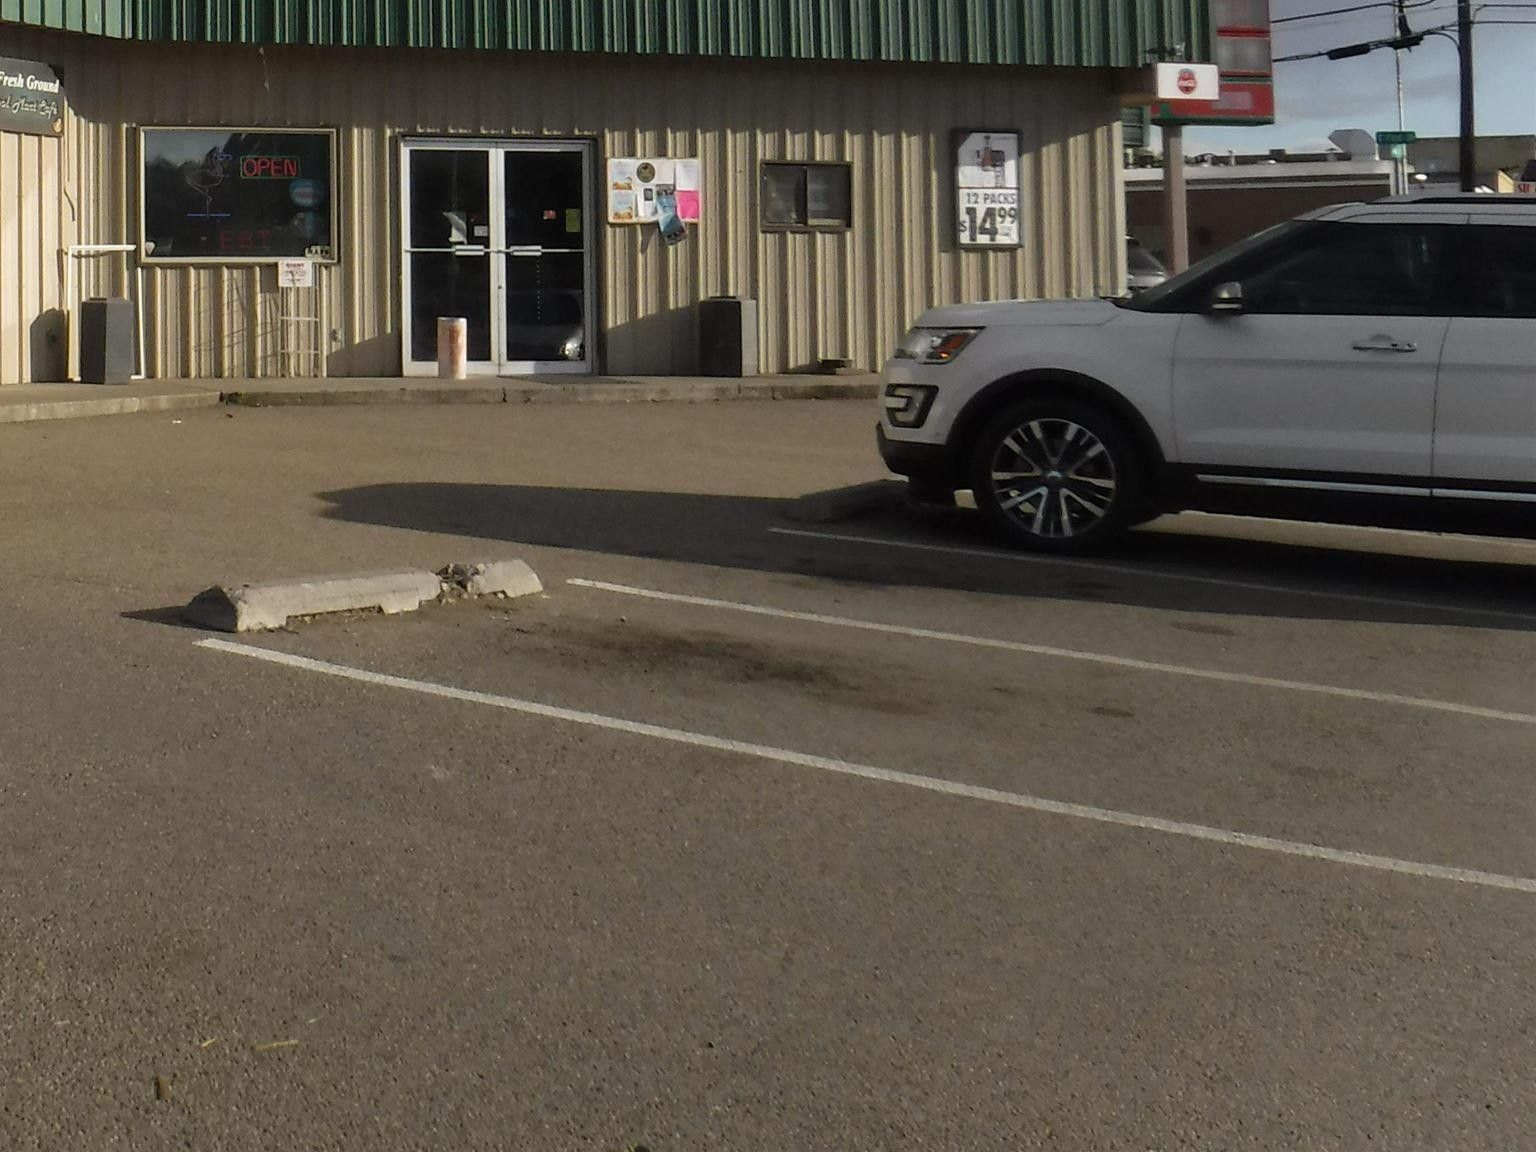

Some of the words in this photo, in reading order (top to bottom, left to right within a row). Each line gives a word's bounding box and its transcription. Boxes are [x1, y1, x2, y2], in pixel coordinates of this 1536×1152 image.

[26, 75, 60, 94] Ground
[243, 157, 298, 177] OPEN
[966, 192, 979, 205] 12
[983, 192, 1017, 205] PACKS
